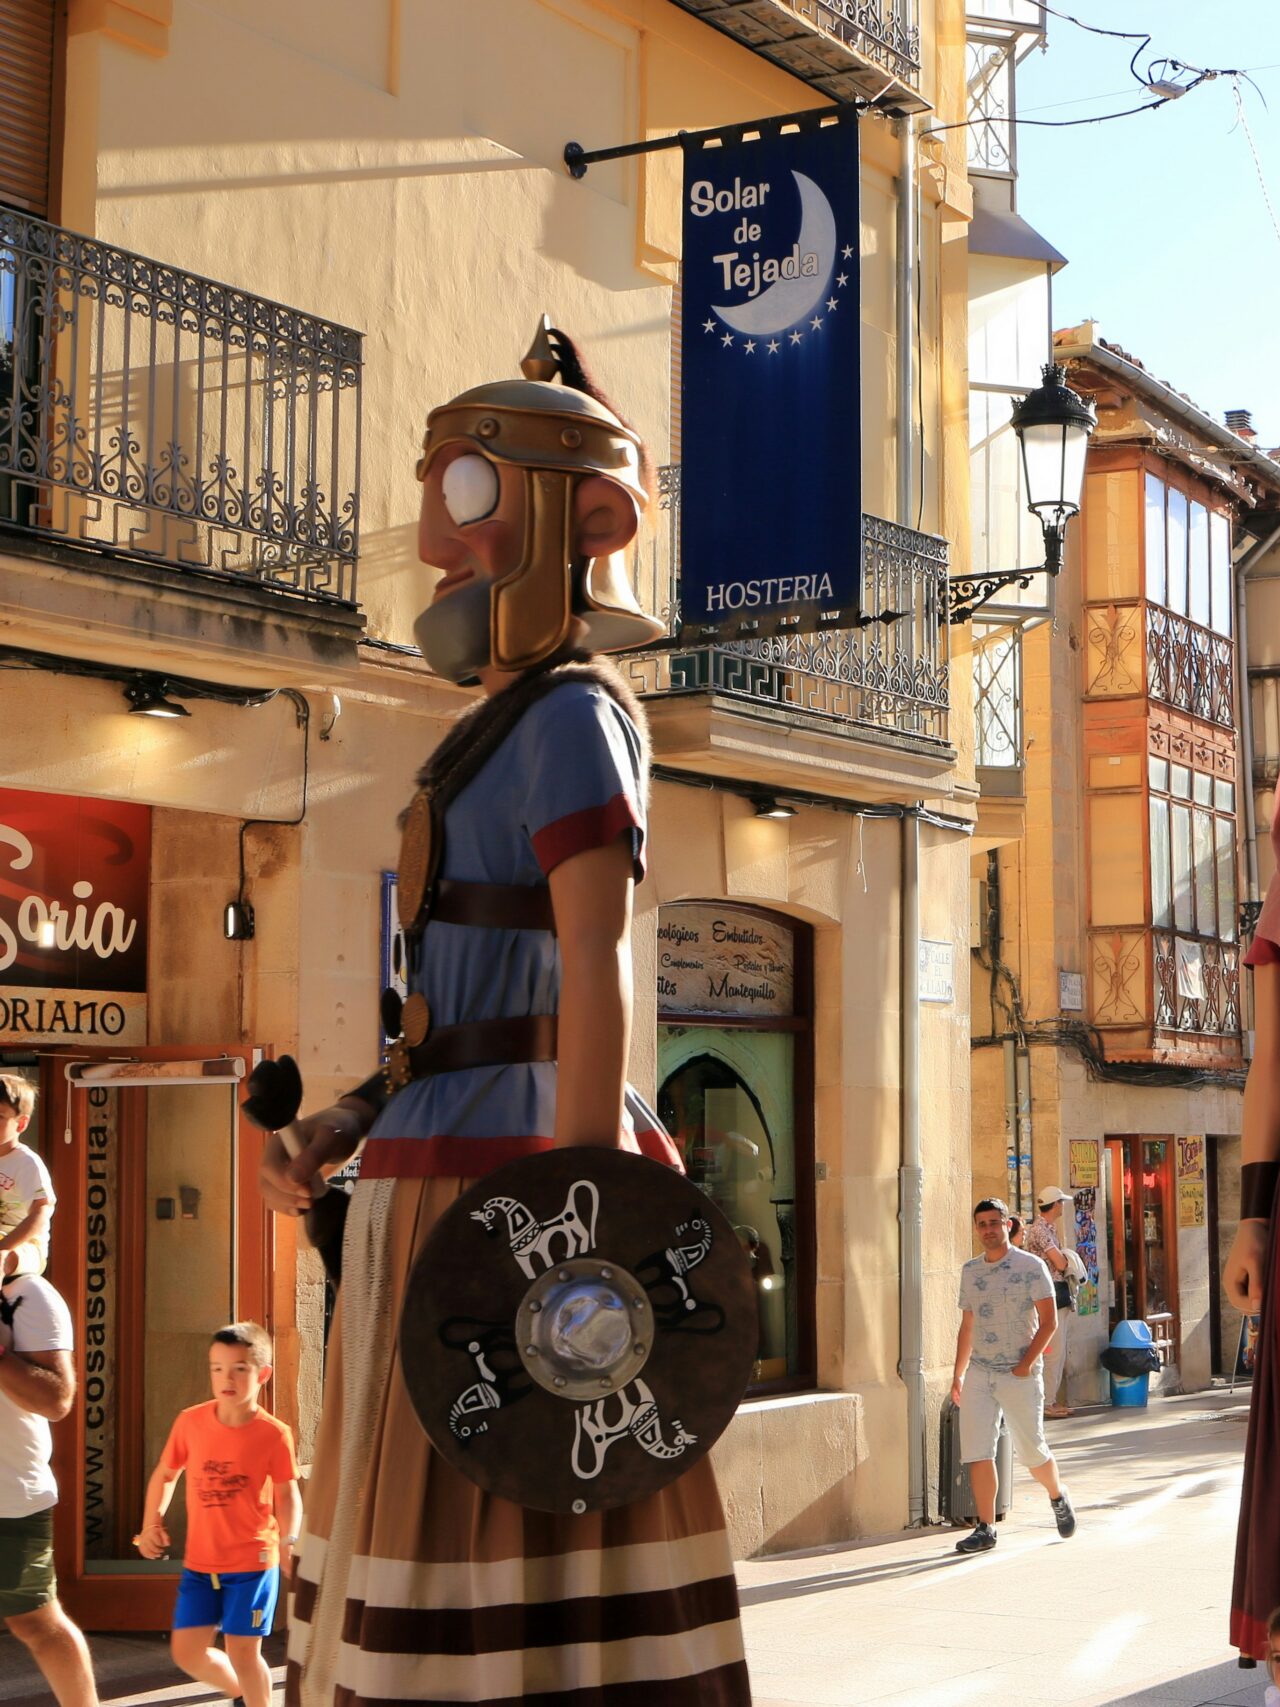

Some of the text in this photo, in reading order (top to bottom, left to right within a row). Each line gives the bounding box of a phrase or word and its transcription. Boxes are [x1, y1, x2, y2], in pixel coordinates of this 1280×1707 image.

[690, 177, 770, 217] Solar
[733, 217, 762, 244] de
[713, 243, 819, 297] Tejada
[706, 572, 833, 611] HOSTERIA
[657, 920, 766, 946] cológicos Embutidos
[708, 972, 776, 1003] Mantequilla
